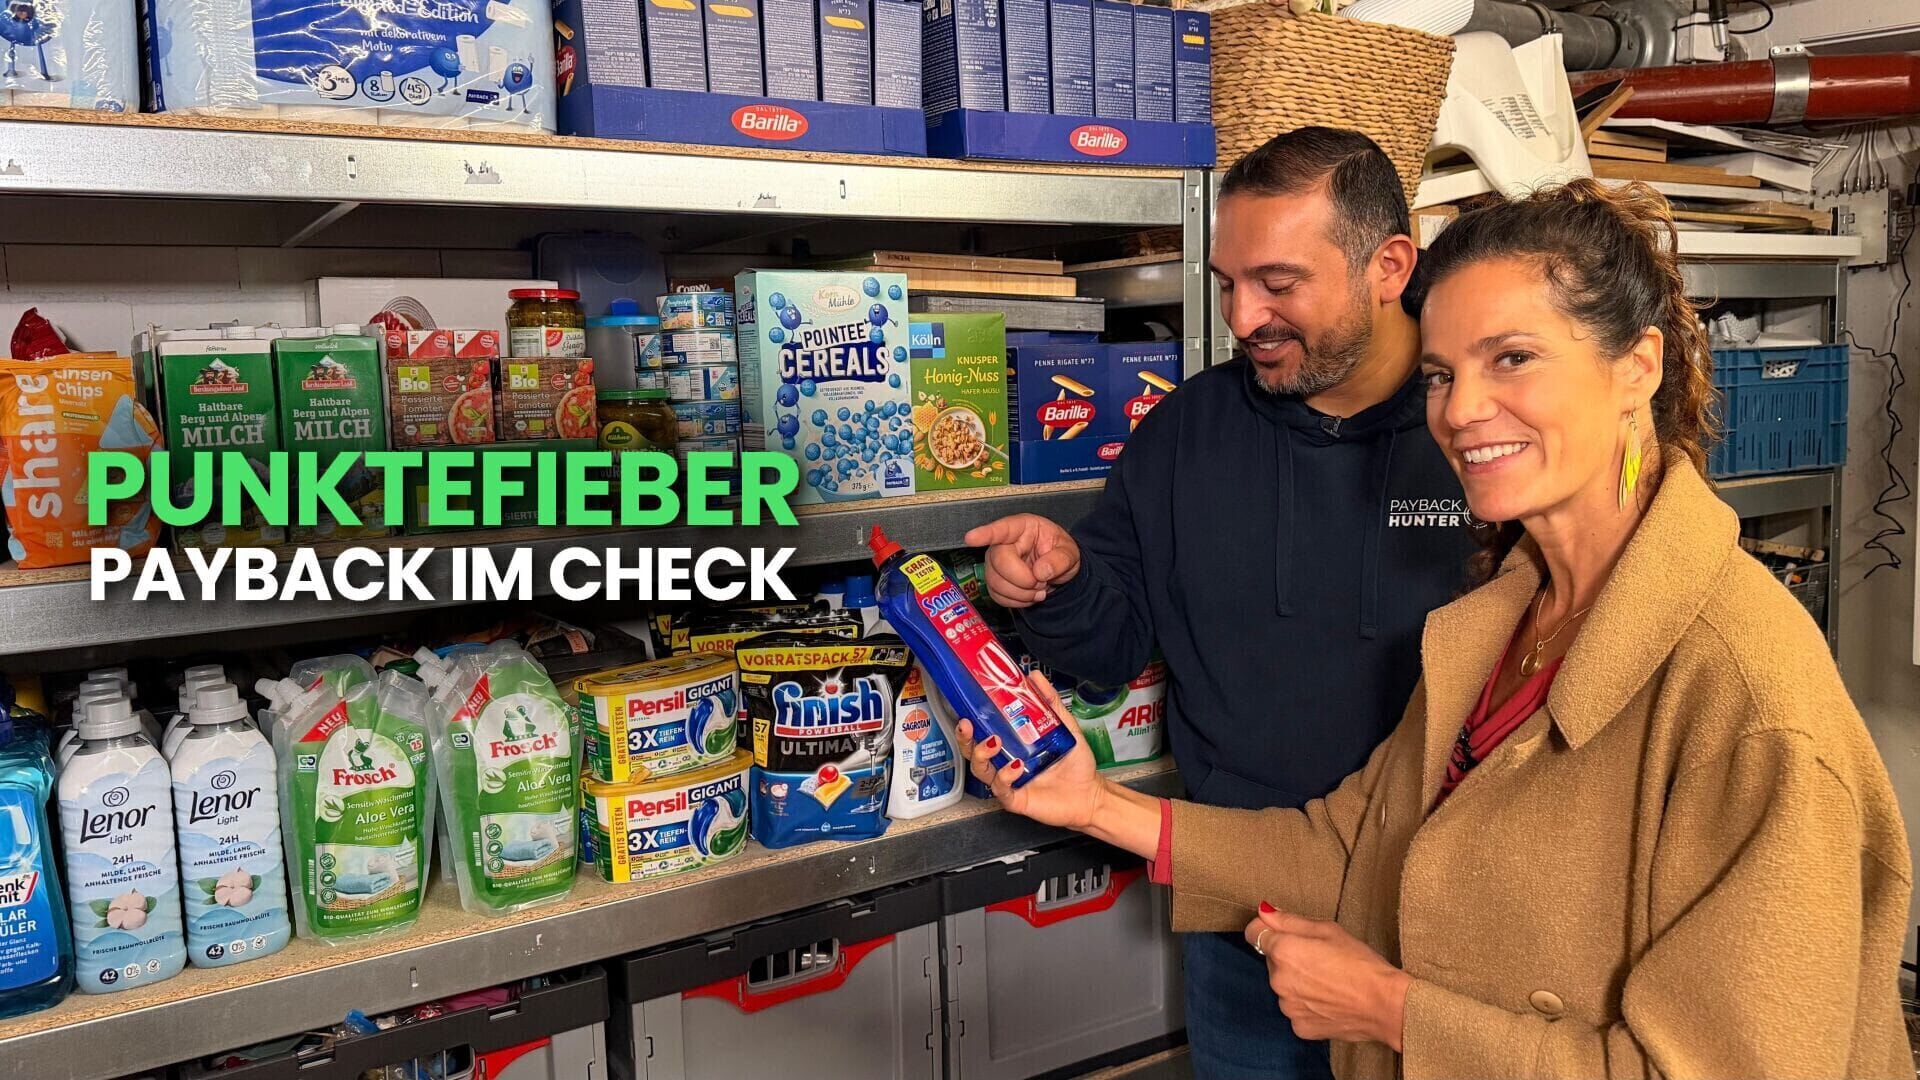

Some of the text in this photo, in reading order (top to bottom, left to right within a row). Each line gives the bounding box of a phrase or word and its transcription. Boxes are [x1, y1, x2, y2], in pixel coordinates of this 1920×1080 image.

[381, 29, 447, 43] dekorativem
[362, 40, 393, 51] Motiv
[370, 80, 380, 92] 8
[407, 84, 423, 94] 45
[741, 113, 799, 133] Barilla
[1076, 133, 1121, 148] Barilla
[677, 284, 711, 293] CORNY
[828, 294, 854, 308] Mühle
[804, 322, 866, 348] POINTEE
[911, 335, 942, 346] Kölln
[778, 346, 889, 379] CEREALS
[957, 356, 999, 365] KNUSPER
[1034, 359, 1054, 367] PENNE
[1057, 358, 1079, 366] RIGATE
[400, 377, 429, 390] Bio
[511, 374, 538, 388] Bio
[924, 368, 1000, 386] Honig-Nuss
[56, 382, 104, 400] Chips
[512, 392, 550, 400] Passierte
[198, 402, 243, 412] Haltbare
[309, 397, 351, 407] Haltbare
[401, 395, 443, 404] Passierte
[514, 400, 551, 409] Tomaten
[293, 407, 370, 420] Berg und Alpen
[402, 405, 444, 413] Tomaten
[1044, 407, 1088, 421] Barilla
[180, 412, 264, 425] Berg und Alpen
[181, 424, 265, 448] MILCH
[294, 418, 371, 441] MILCH
[13, 374, 62, 518] share
[1390, 499, 1462, 512] PAYBACK
[1388, 515, 1460, 527] HUNTER
[963, 582, 977, 595] 50
[744, 647, 867, 667] VORRATSPACK 57
[688, 677, 732, 700] GIGANT
[469, 691, 485, 712] NEU
[629, 690, 685, 718] Persil
[773, 677, 884, 728] finish
[318, 712, 342, 735] NEU
[615, 706, 626, 736] TESTEN
[754, 722, 767, 733] 57
[901, 719, 931, 732] SAGROTAN
[798, 724, 861, 735] POWERBALL
[410, 740, 422, 750] 25
[490, 733, 557, 759] Frosch
[629, 726, 685, 751] 3X TIEFEN-
[659, 734, 675, 744] REIN
[617, 737, 627, 765] GRATIS
[780, 738, 876, 755] ULTIMATE
[333, 767, 397, 786] Frosch
[517, 773, 571, 793] Aloe Vera
[691, 777, 739, 802] GIGANT
[189, 787, 260, 825] Lenor
[347, 790, 414, 809] Sensitiv-Waschmittel
[629, 792, 687, 818] Persil
[217, 814, 239, 826] Light
[355, 803, 415, 825] Aloe Vera
[615, 807, 626, 836] TESTEN
[80, 804, 155, 844] Lenor
[110, 833, 133, 845] Light
[218, 834, 240, 846] 24H
[629, 827, 688, 852] 3X TIEFEN-
[660, 836, 677, 845] REIN
[193, 848, 266, 867] ANHALTENDE FRISCHE
[208, 844, 252, 858] MILDE, LANG
[617, 838, 627, 865] GRATIS
[112, 854, 134, 866] 24H
[84, 869, 162, 888] ANHALTENDE FRISCHE
[101, 864, 147, 878] MILDE, LANG
[199, 911, 270, 931] FRISCHE BAUMWOLLBLÜTE
[323, 911, 364, 920] BIO-QUALITÄT
[92, 934, 165, 955] FRISCHE BAUMWOLLBLÜTE
[208, 941, 245, 957] 42 0%
[102, 965, 139, 981] 42 0%
